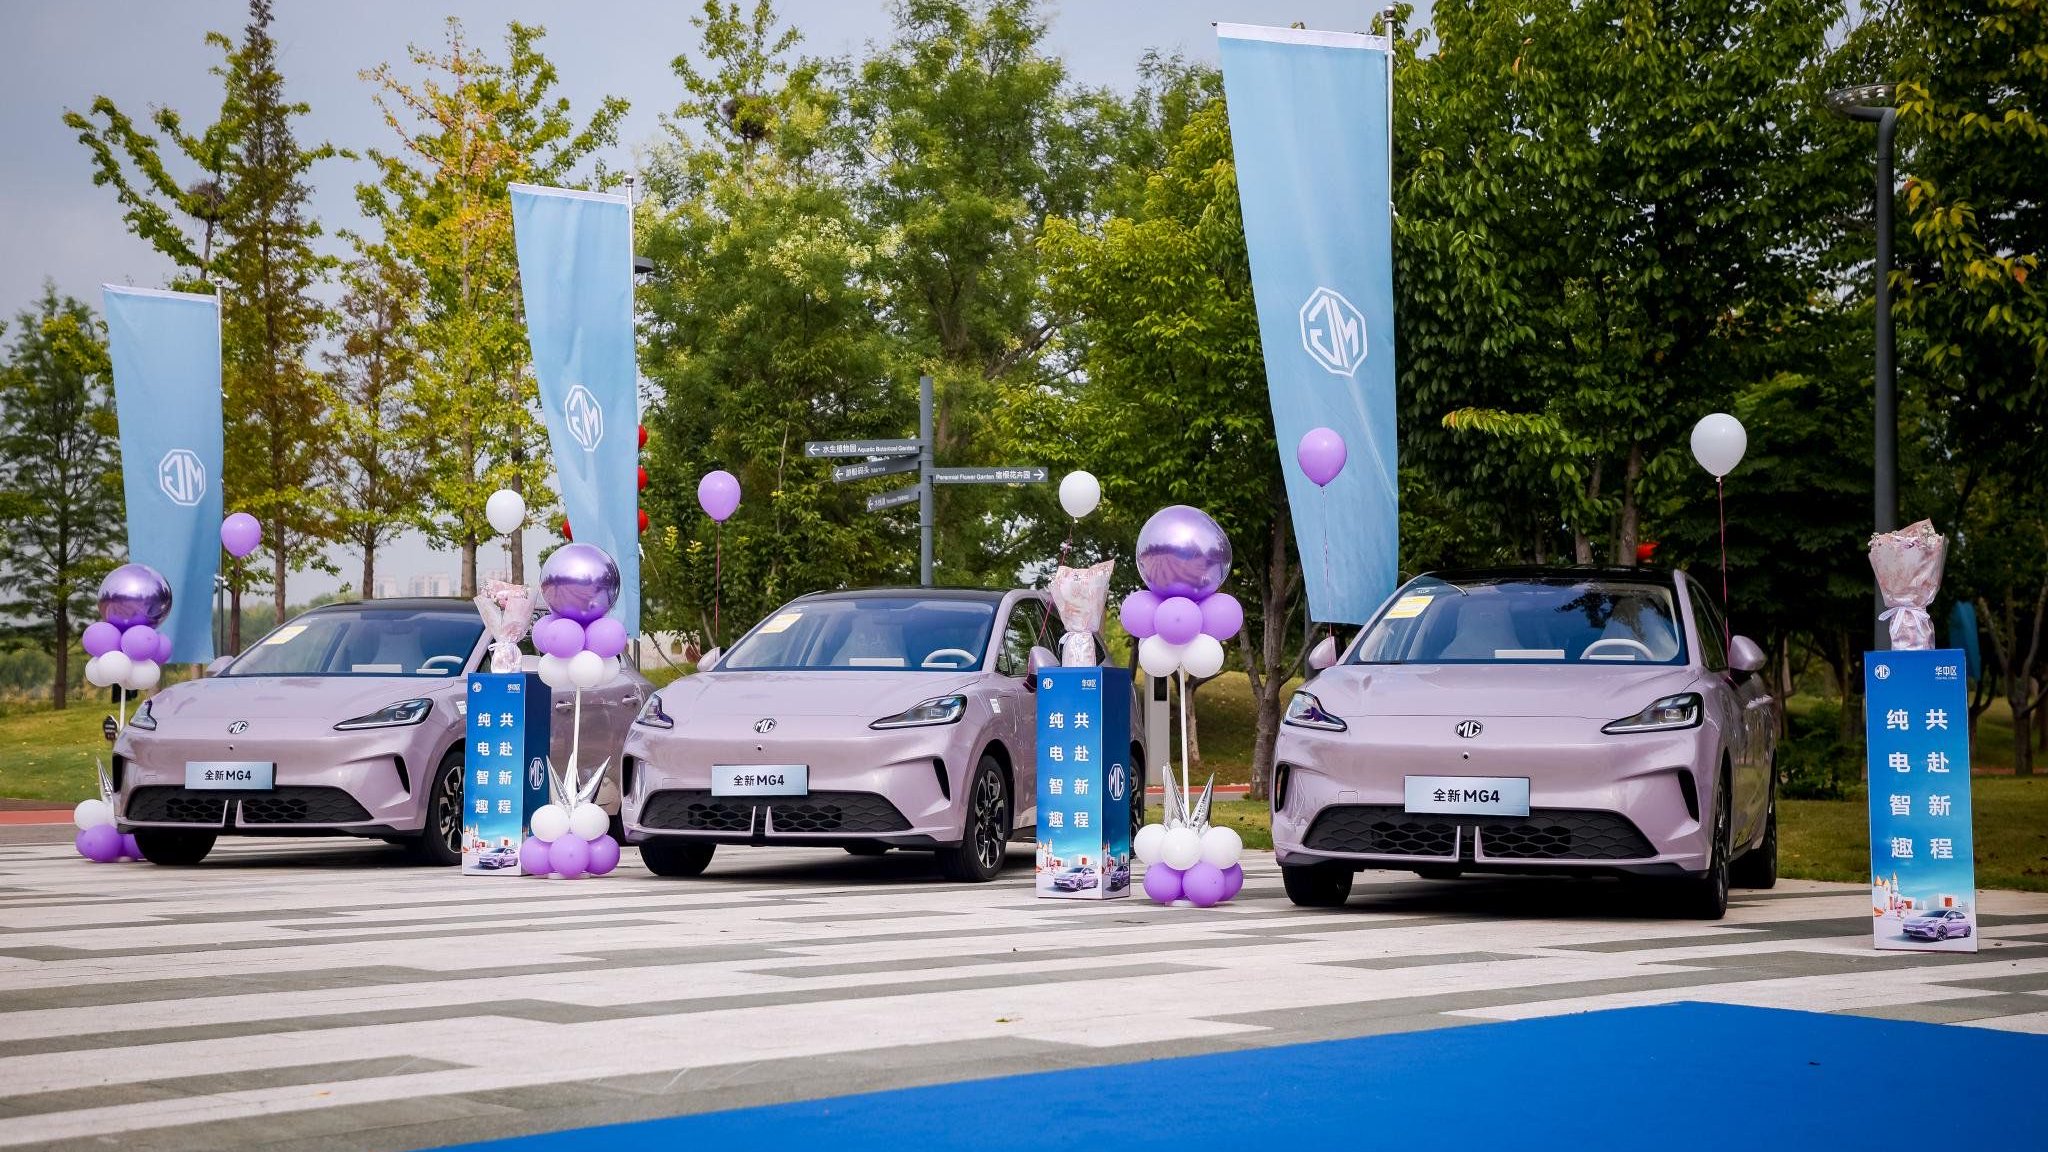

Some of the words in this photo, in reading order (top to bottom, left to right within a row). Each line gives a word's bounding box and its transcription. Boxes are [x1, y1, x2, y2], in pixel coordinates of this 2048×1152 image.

[822, 444, 857, 453] 水生植物园
[1875, 665, 1890, 679] MG
[1934, 665, 1957, 677] 华中区
[229, 721, 248, 734] MG
[755, 719, 775, 733] MG
[1456, 720, 1482, 738] MG
[475, 712, 492, 814] 纯电智趣
[498, 712, 514, 814] 共赴新程
[529, 759, 544, 789] MG
[1048, 712, 1065, 828] 纯电智趣
[1073, 712, 1090, 828] 共赴新程
[1108, 765, 1124, 800] MG
[1886, 708, 1914, 860] 纯电智趣
[1925, 708, 1953, 860] 共赴新程
